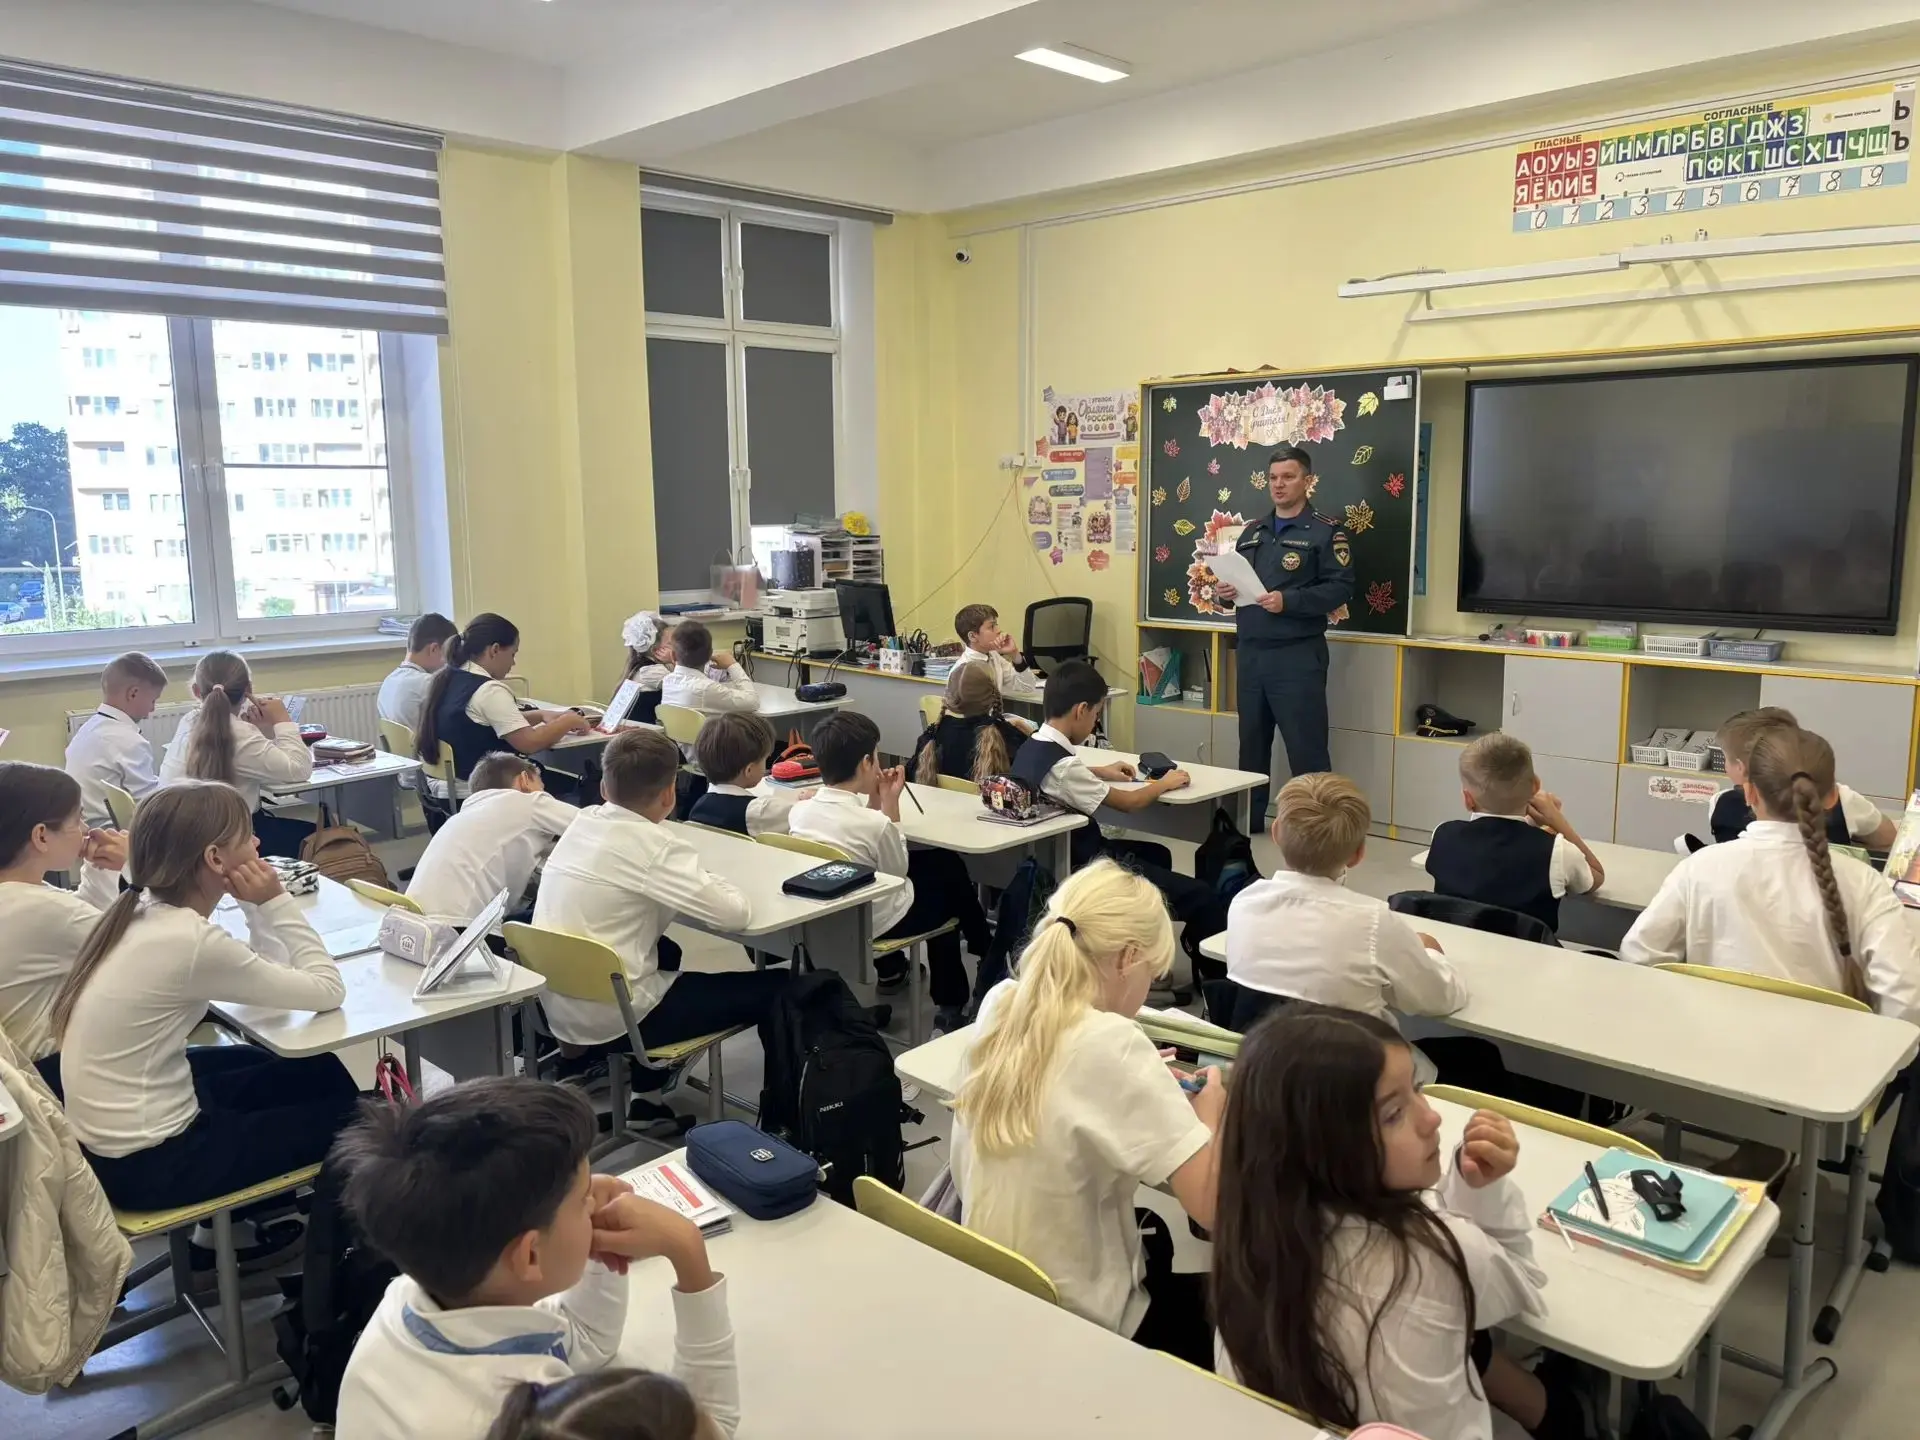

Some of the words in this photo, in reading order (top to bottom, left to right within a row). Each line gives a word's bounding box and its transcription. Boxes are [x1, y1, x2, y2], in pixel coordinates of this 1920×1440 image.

[1703, 102, 1774, 122] СОГЛАСНЫЕ
[1534, 134, 1583, 150] ГЛАСНЫЕ
[1535, 210, 1548, 229] 0
[1569, 205, 1581, 224] 1
[1600, 200, 1615, 220] 2
[1634, 196, 1650, 216] 3
[1673, 190, 1686, 210] 4
[1707, 186, 1722, 206] 5
[1746, 180, 1761, 201] 6
[1786, 176, 1801, 196] 7
[1826, 170, 1842, 192] 8
[1869, 165, 1884, 186] 9
[1087, 414, 1117, 422] РОССИИ
